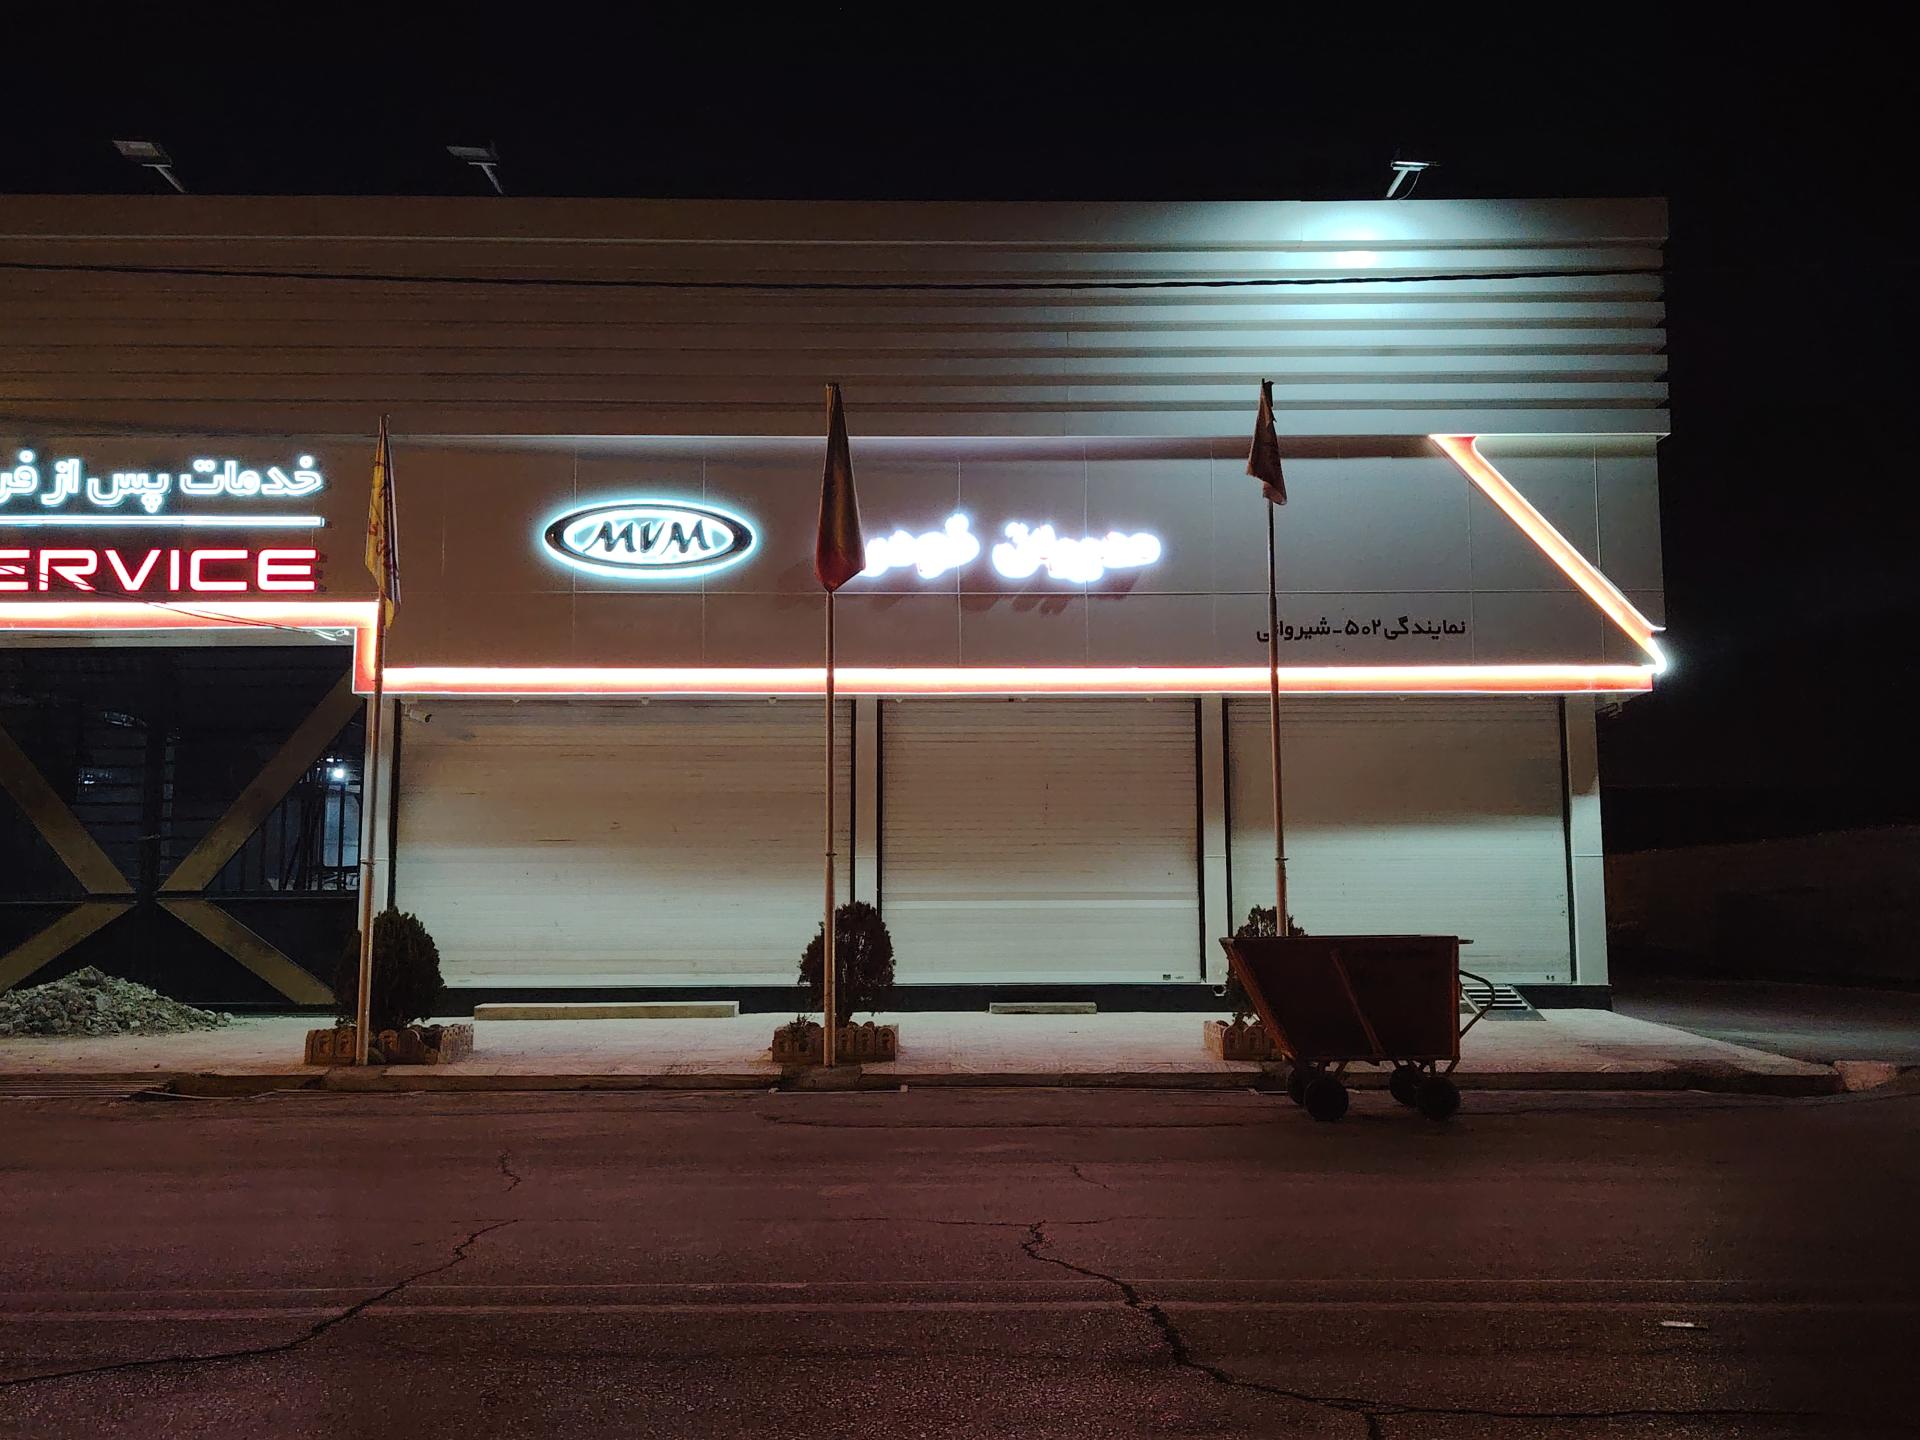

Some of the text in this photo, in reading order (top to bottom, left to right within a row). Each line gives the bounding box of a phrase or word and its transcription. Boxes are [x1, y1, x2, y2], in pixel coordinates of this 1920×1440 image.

[41, 458, 80, 506] از
[87, 473, 172, 513] پس
[180, 456, 324, 497] خدمات
[582, 519, 711, 555] MVM
